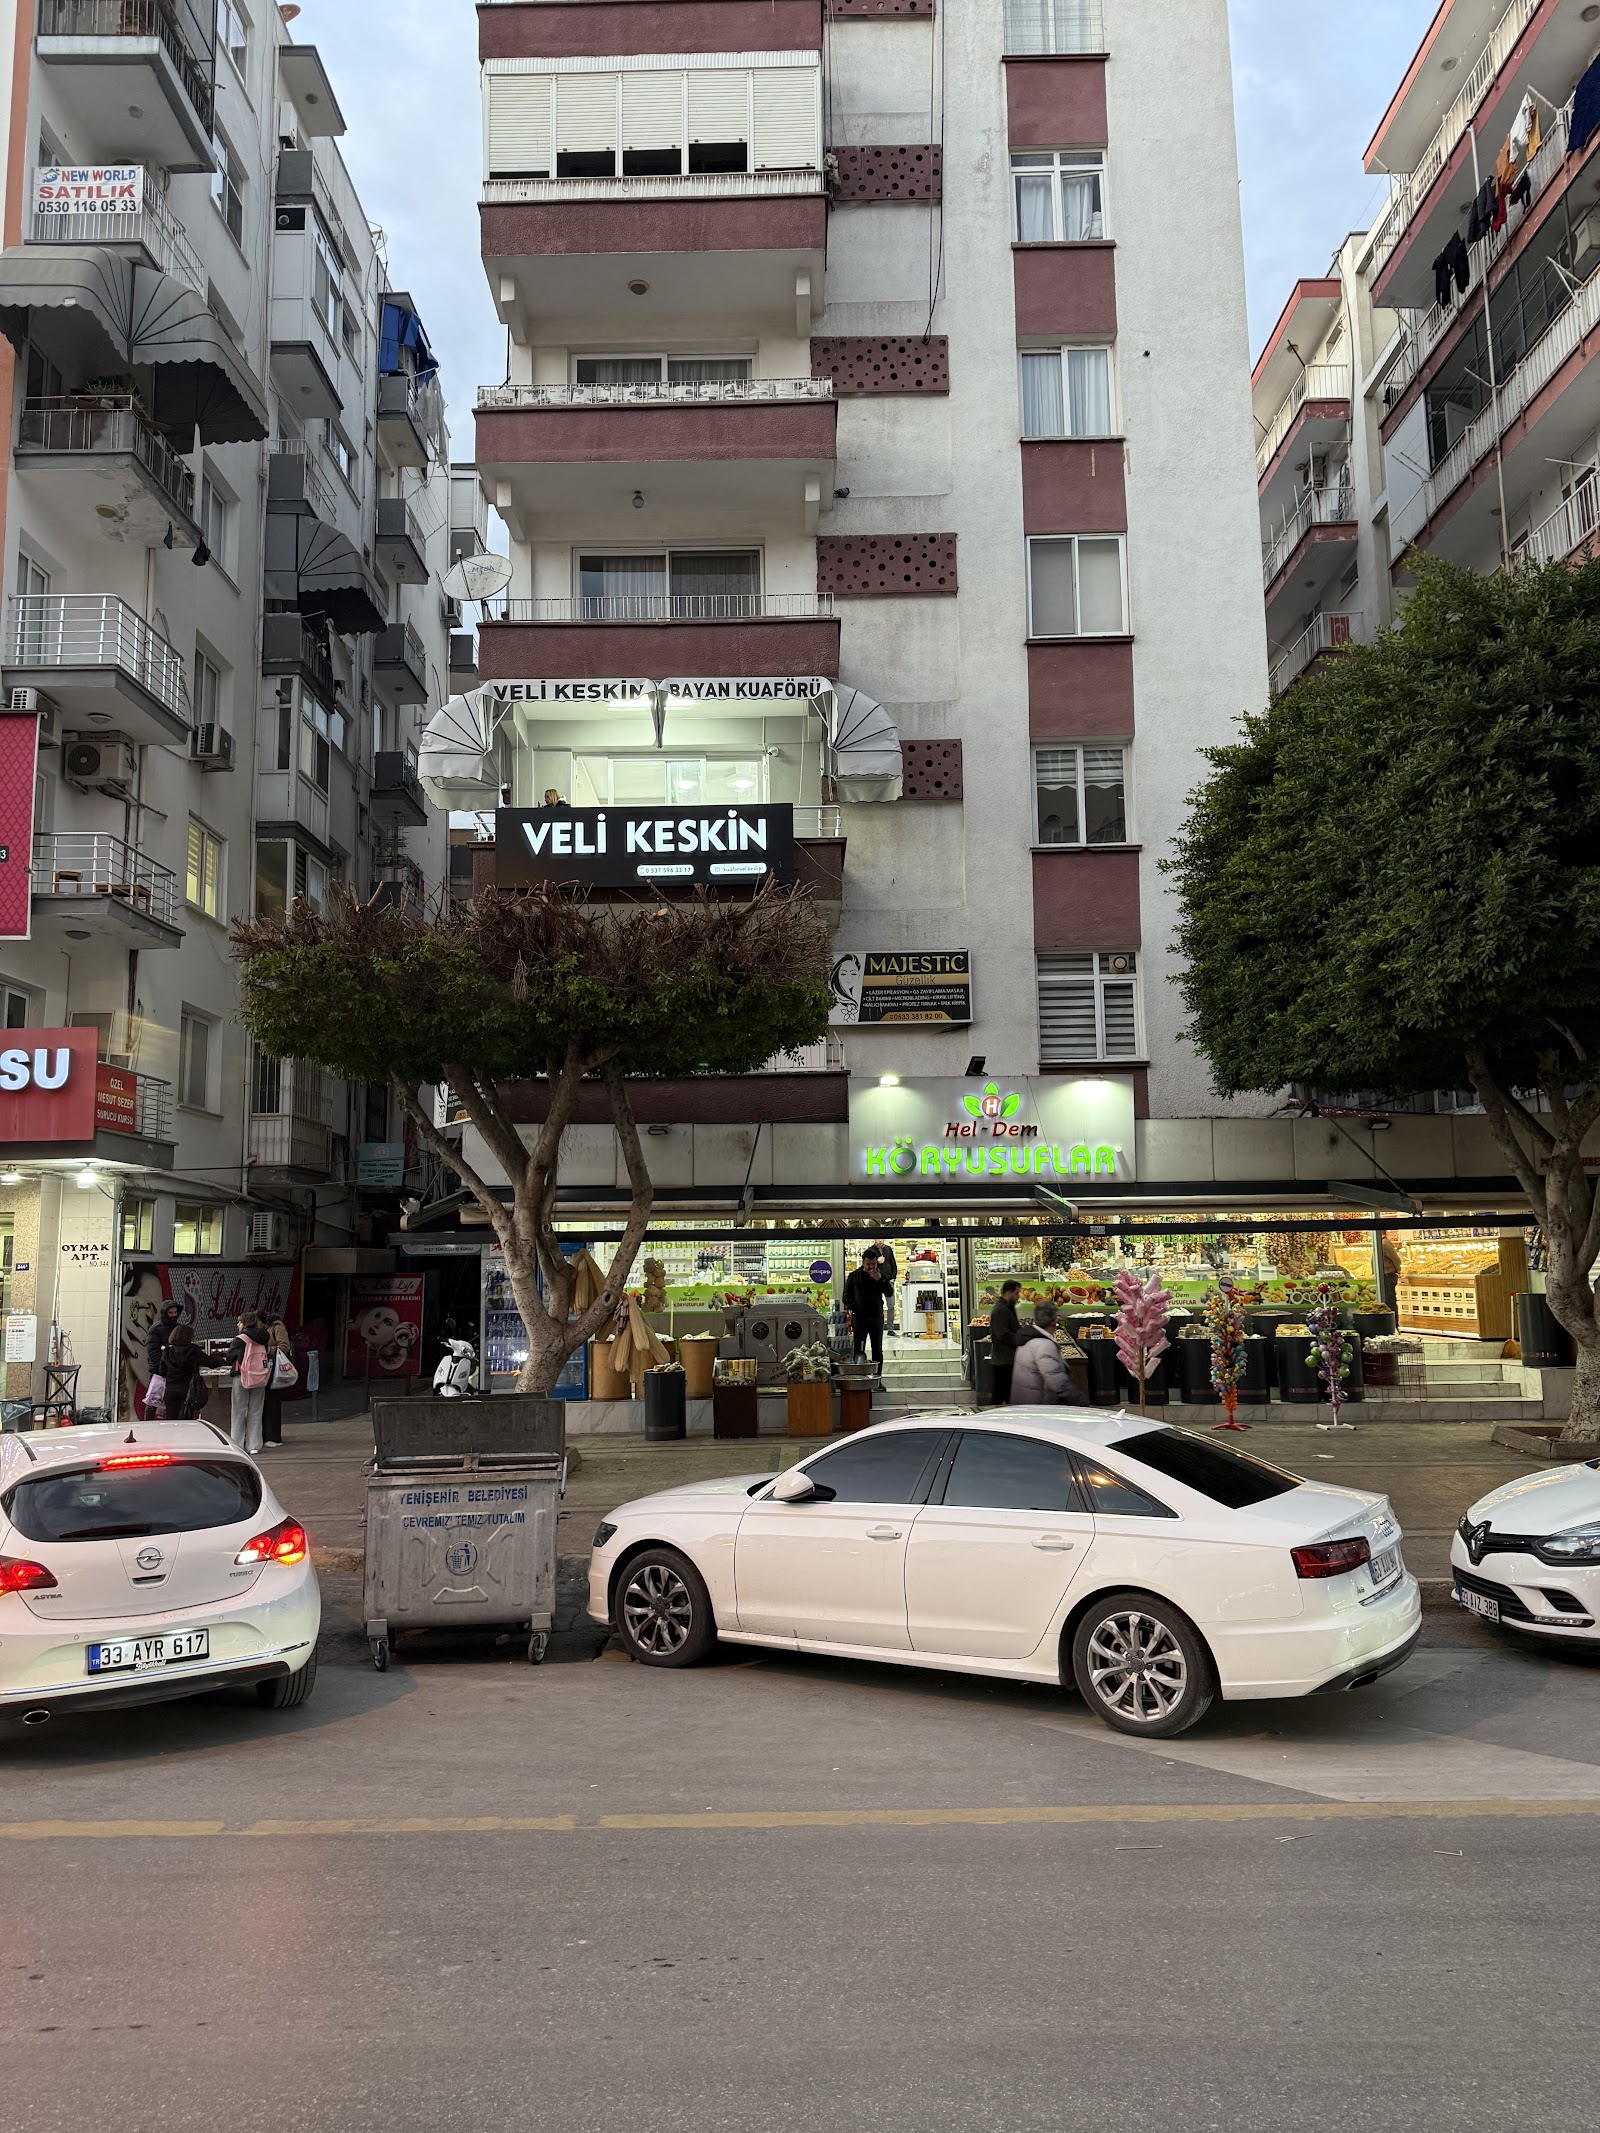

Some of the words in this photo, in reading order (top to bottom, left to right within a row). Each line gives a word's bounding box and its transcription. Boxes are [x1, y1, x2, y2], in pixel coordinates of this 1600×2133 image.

[62, 170, 88, 182] NEW
[92, 170, 136, 182] WORLD
[39, 184, 136, 199] SATILIK
[38, 201, 70, 213] 0530
[74, 200, 96, 212] 116
[100, 200, 116, 212] 05
[121, 200, 136, 212] 33
[493, 680, 546, 700] VELİ
[555, 680, 643, 700] KESKİN
[670, 682, 730, 698] BAYAN
[736, 678, 820, 698] KUAFÖRÜ
[522, 813, 607, 855] VELİ
[626, 809, 767, 852] KESKİN
[896, 975, 936, 986] Güzellik
[98, 1092, 116, 1105] MESUT
[118, 1096, 134, 1110] SEZER
[946, 1121, 976, 1137] Hel
[993, 1122, 1038, 1137] Dem
[866, 1137, 1116, 1176] KÖRYUSUFLAR
[62, 1244, 110, 1252] OYMAK
[400, 1488, 460, 1507] YENİŞEHİR
[468, 1486, 528, 1502] BELEDİYESİ
[102, 1646, 122, 1665] 33
[133, 1640, 164, 1662] AYR
[174, 1634, 204, 1655] 617
